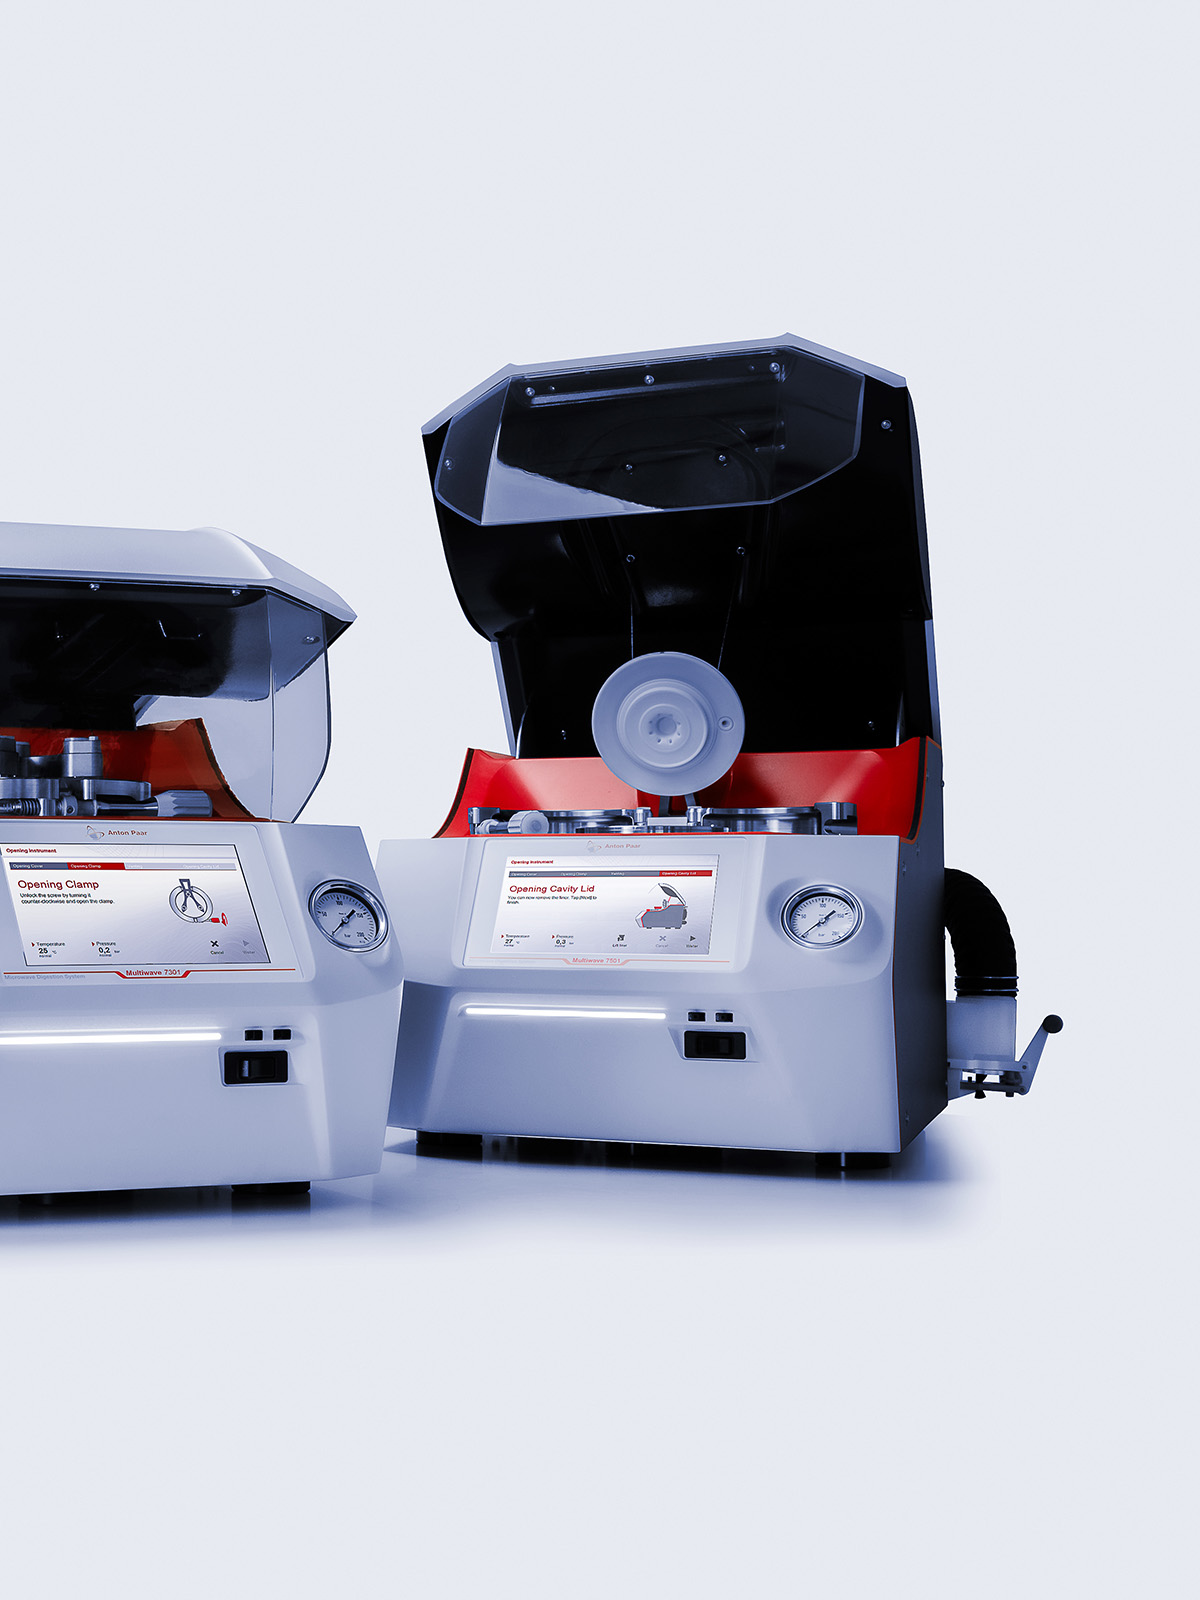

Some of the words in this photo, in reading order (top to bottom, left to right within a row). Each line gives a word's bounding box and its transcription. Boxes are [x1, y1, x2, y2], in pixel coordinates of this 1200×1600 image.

[18, 880, 63, 890] Opening
[65, 880, 99, 890] Clamp
[509, 885, 547, 894] Opening
[550, 885, 578, 894] Cavity
